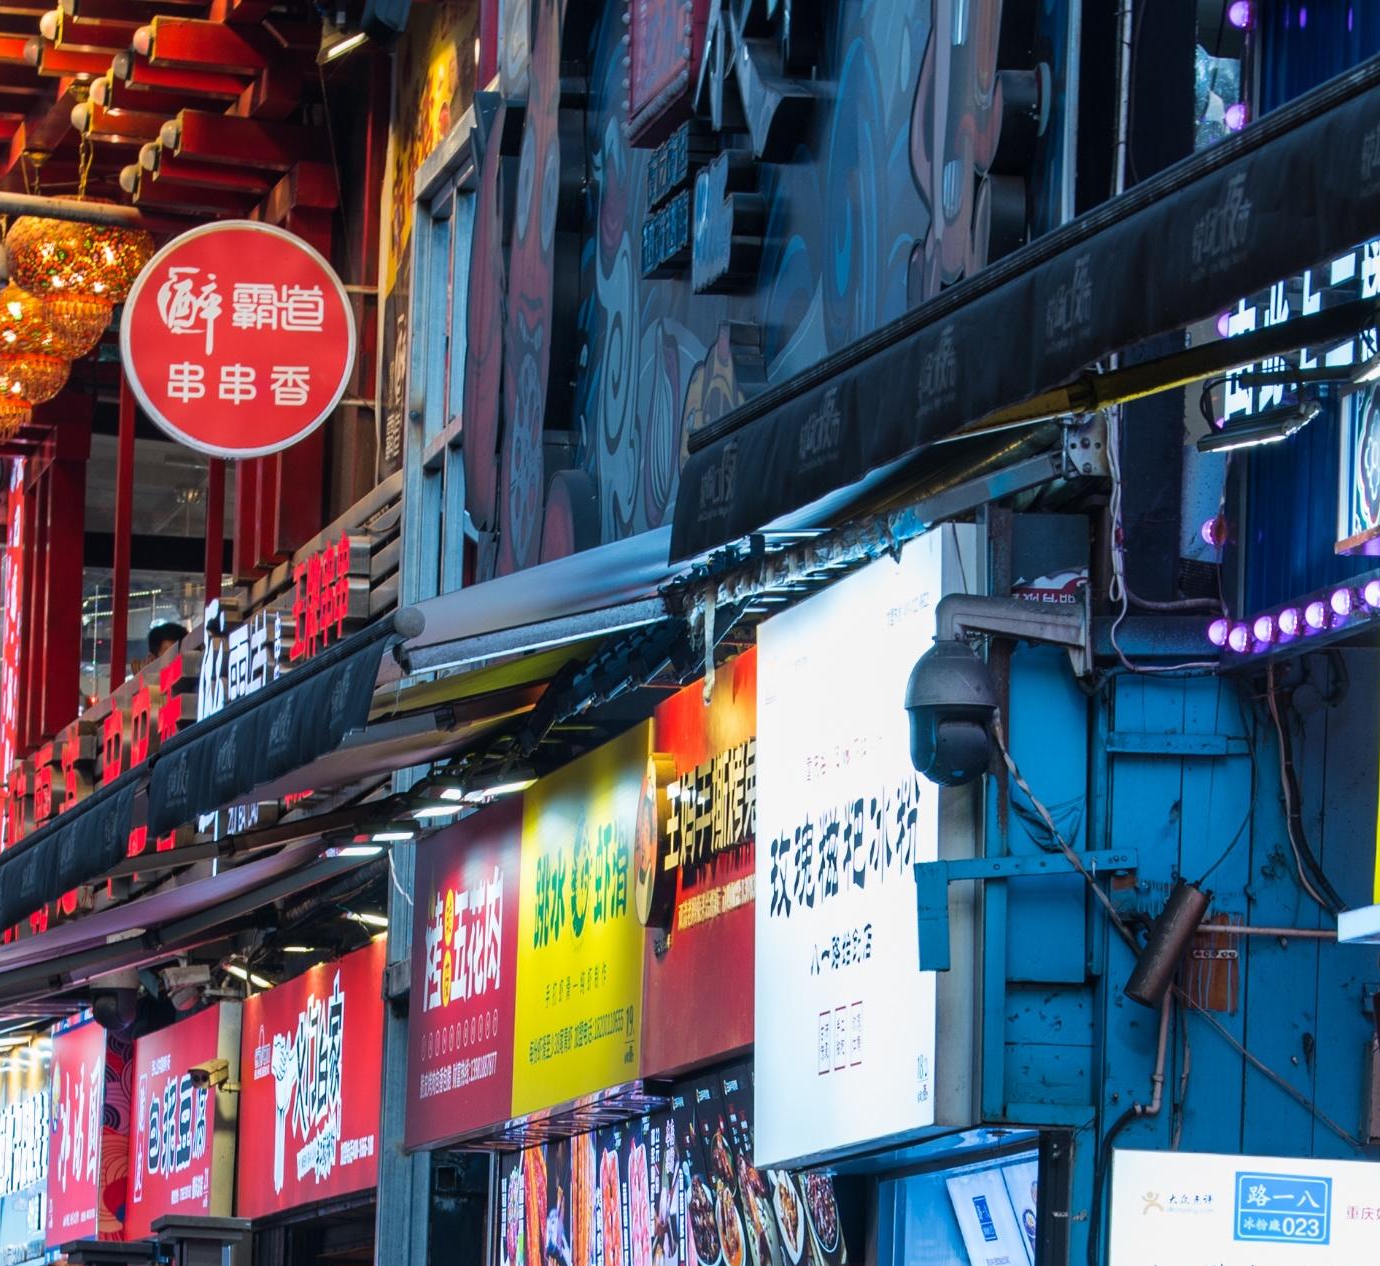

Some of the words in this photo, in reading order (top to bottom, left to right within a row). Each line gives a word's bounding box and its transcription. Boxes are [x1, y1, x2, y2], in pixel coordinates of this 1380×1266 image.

[157, 266, 325, 356] 醉霸道
[167, 362, 310, 406] 串串香
[1246, 1184, 1320, 1208] 路一八
[1282, 1217, 1320, 1238] 023
